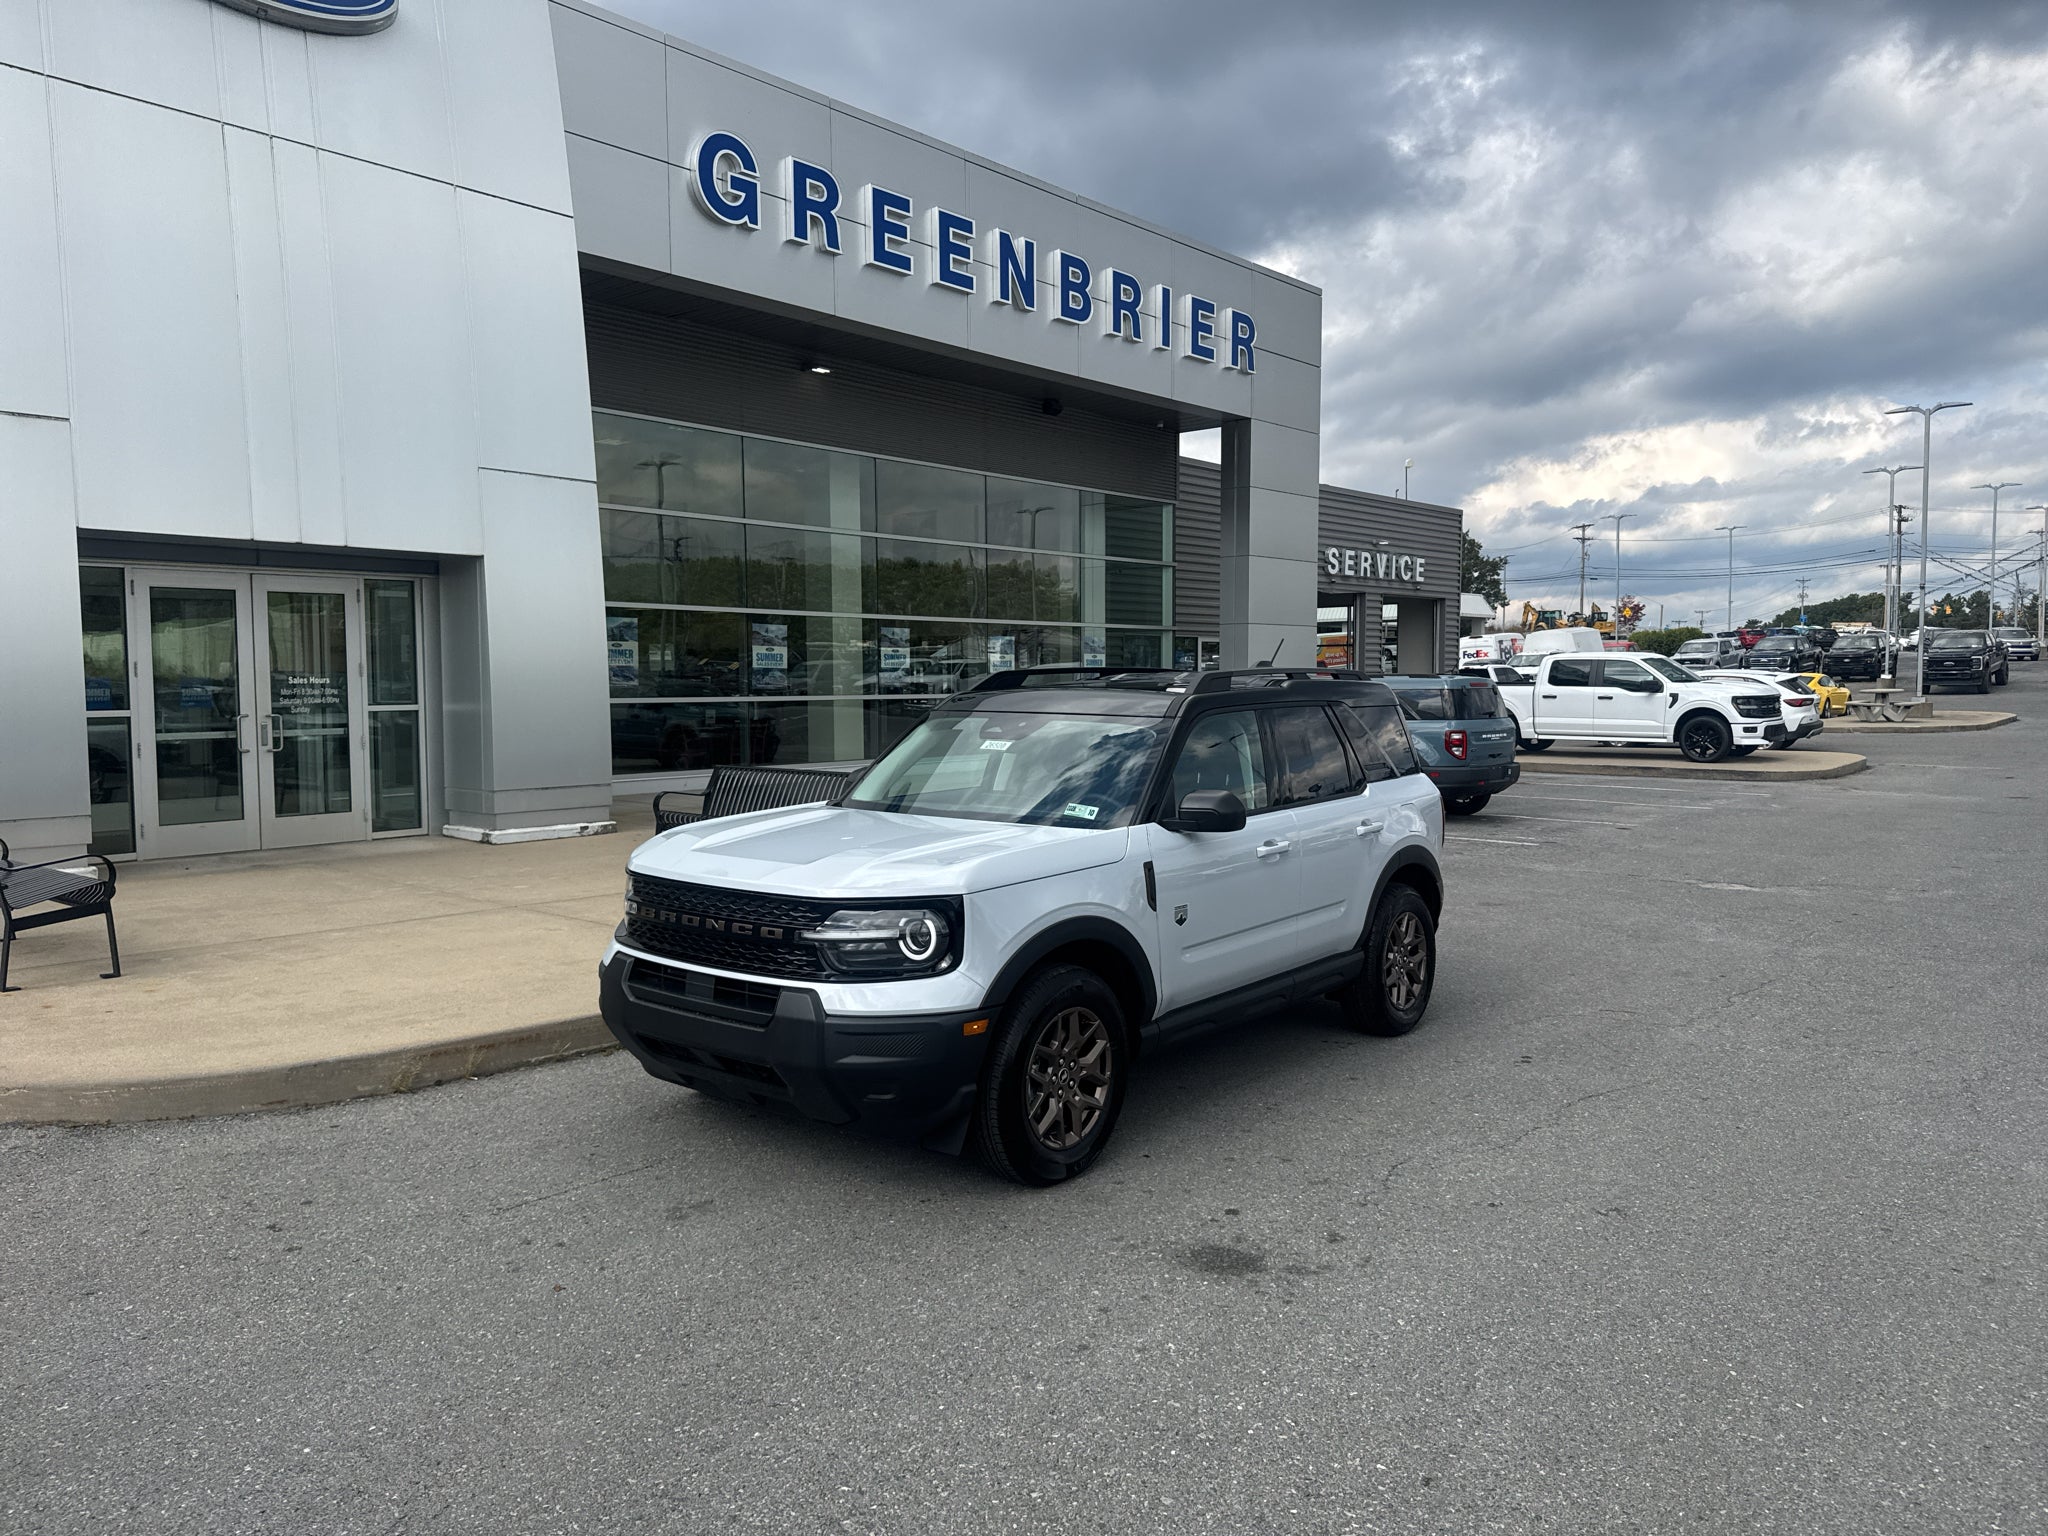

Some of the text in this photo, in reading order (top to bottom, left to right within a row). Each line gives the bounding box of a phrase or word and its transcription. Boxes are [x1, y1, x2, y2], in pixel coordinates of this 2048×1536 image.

[693, 130, 1257, 374] GREENBRIER
[1326, 547, 1425, 582] SERVICE
[608, 649, 634, 659] MMER
[755, 652, 784, 662] SUMMER
[1462, 649, 1489, 659] FedEx
[288, 676, 330, 684] Sales Hours
[280, 687, 301, 696] Mon-Fri
[279, 697, 303, 706] Saturday
[290, 705, 310, 714] Sunday
[640, 906, 784, 940] BRONCO
